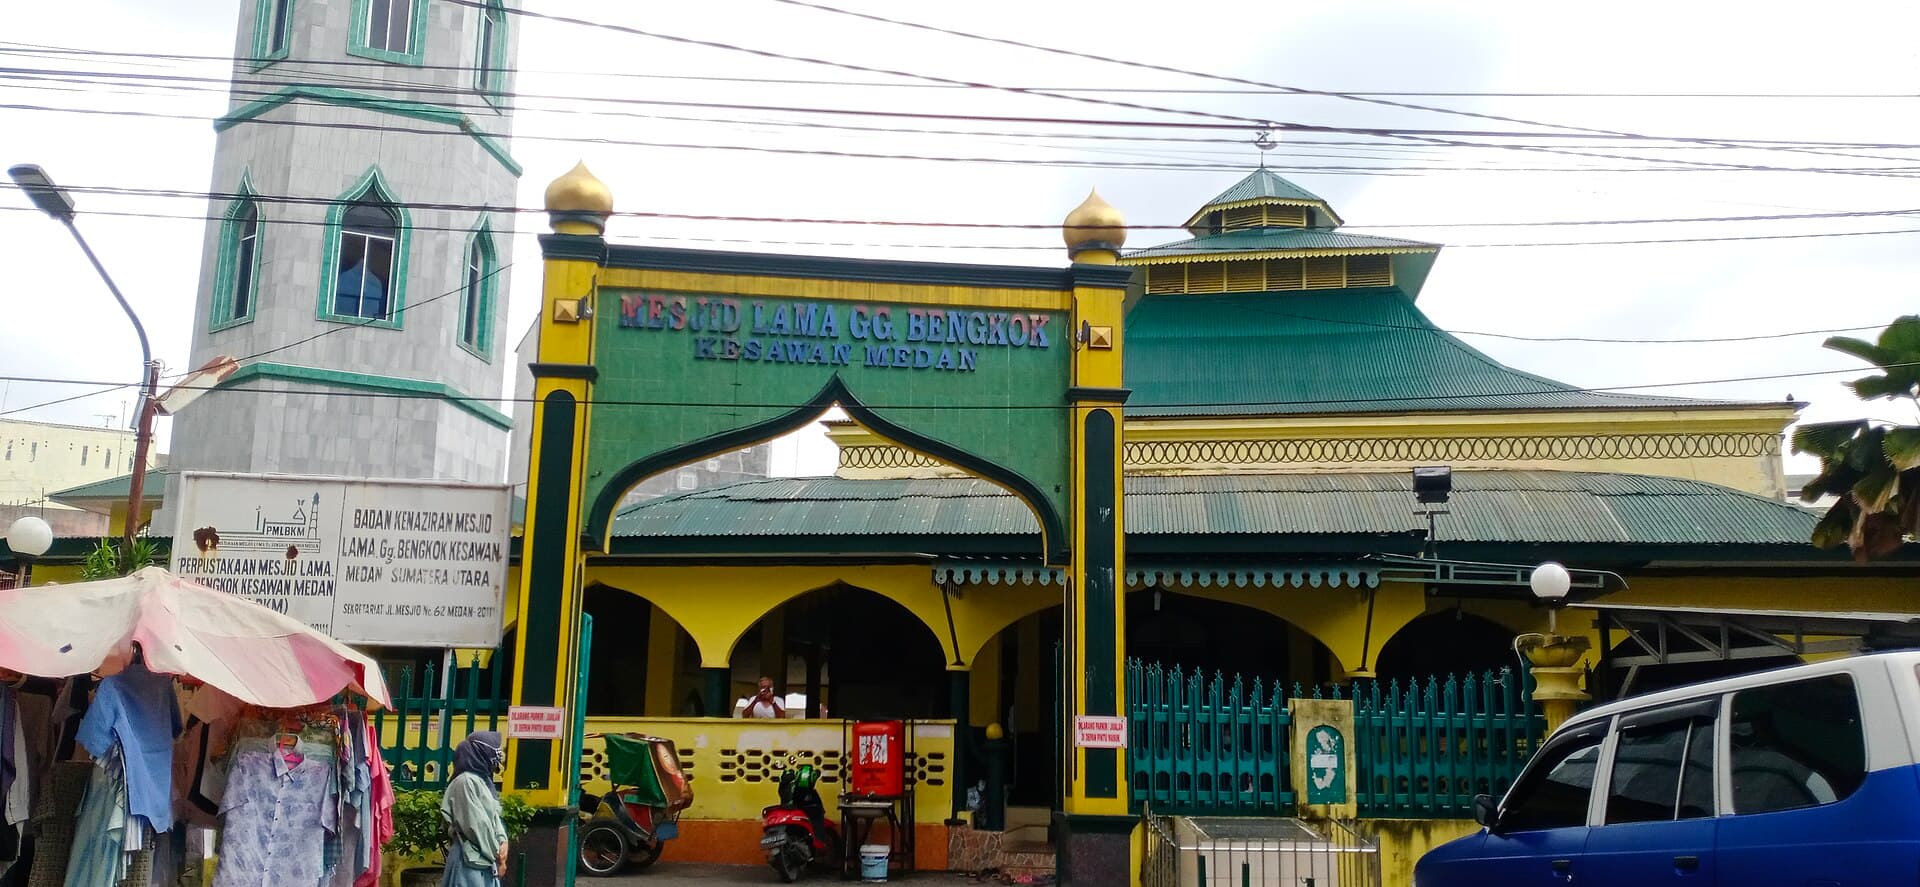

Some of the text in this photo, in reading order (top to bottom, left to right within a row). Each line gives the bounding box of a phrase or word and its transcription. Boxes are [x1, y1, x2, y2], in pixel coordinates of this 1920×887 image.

[620, 294, 1050, 348] MESJID LAMA GG. BENGKOK
[694, 336, 977, 372] KESAWAN MEDAN
[266, 525, 305, 537] PMLBKM
[354, 508, 492, 534] BADAN KENAZIRAN MESJID
[397, 539, 447, 561] BENGKOK
[449, 541, 500, 563] KESAWAN
[179, 557, 256, 575] PERPUSTAKAAN
[258, 558, 297, 577] MESJID
[345, 565, 490, 587] MEDAN SUMATERA UTARA
[240, 578, 291, 596] KESAWAN
[293, 580, 334, 597] MEDAN
[343, 603, 383, 615] SEKRETARIAT
